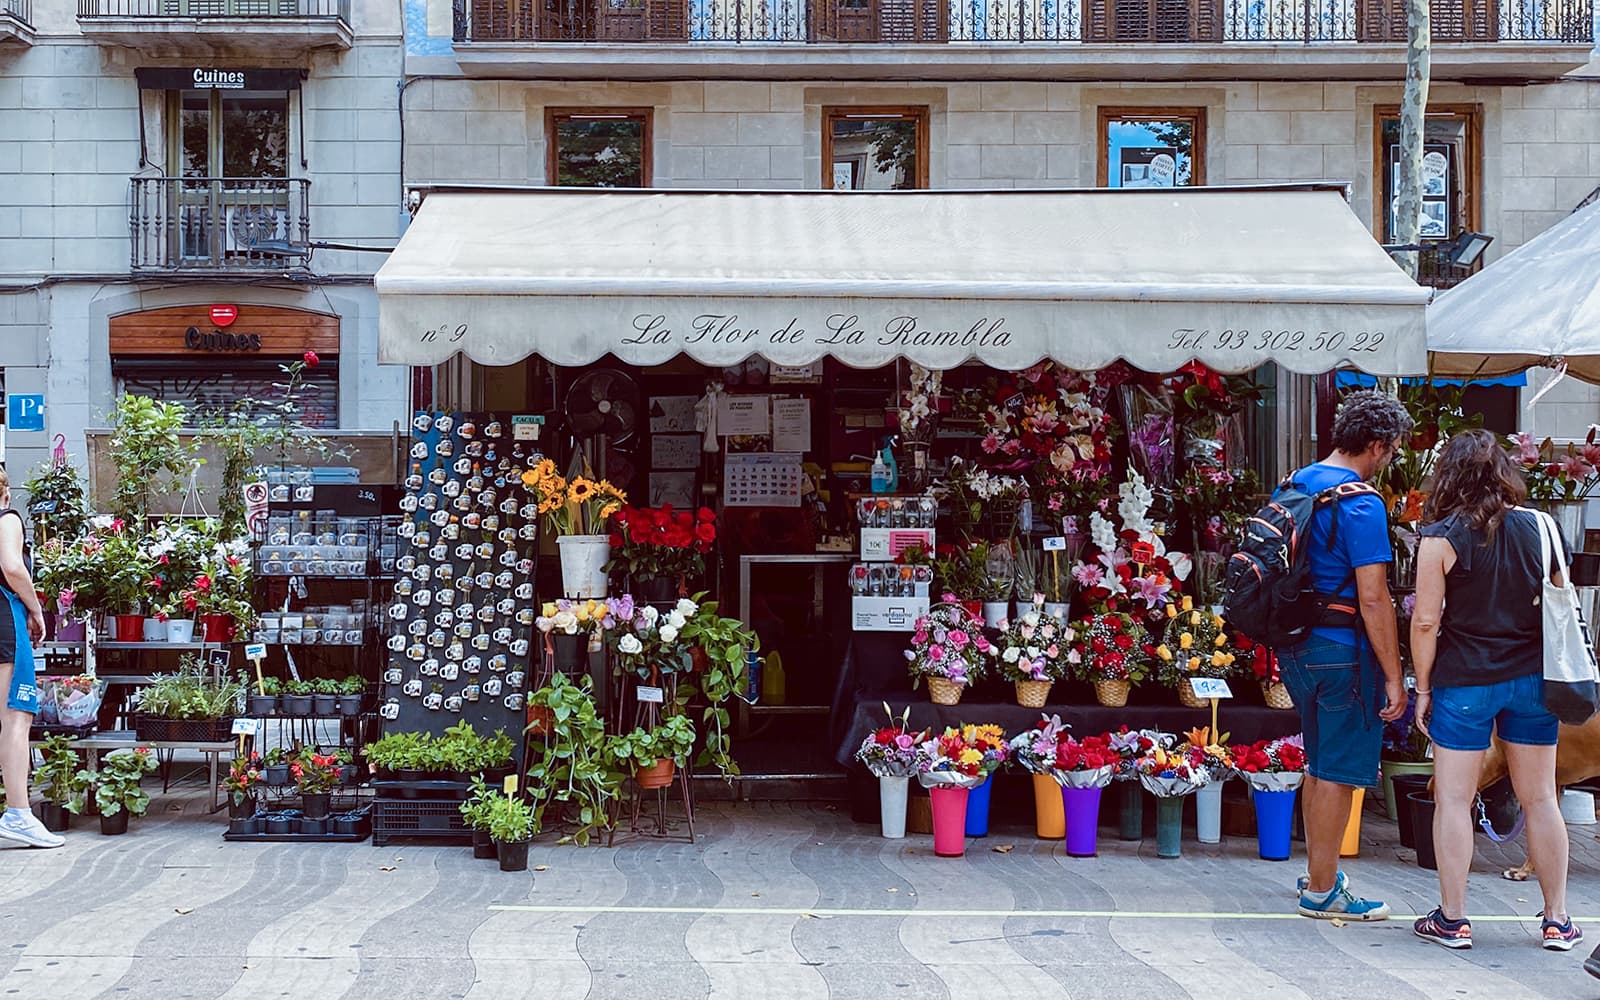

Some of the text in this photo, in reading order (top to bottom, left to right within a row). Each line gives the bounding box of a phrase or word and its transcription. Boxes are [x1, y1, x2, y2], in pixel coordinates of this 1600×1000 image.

[193, 68, 244, 83] Cuines
[185, 326, 262, 351] Cuines
[449, 324, 468, 343] 9
[620, 314, 1013, 347] La Flor de La Rambla
[1167, 328, 1385, 352] Tel. 93 302 50 22
[21, 398, 35, 417] P
